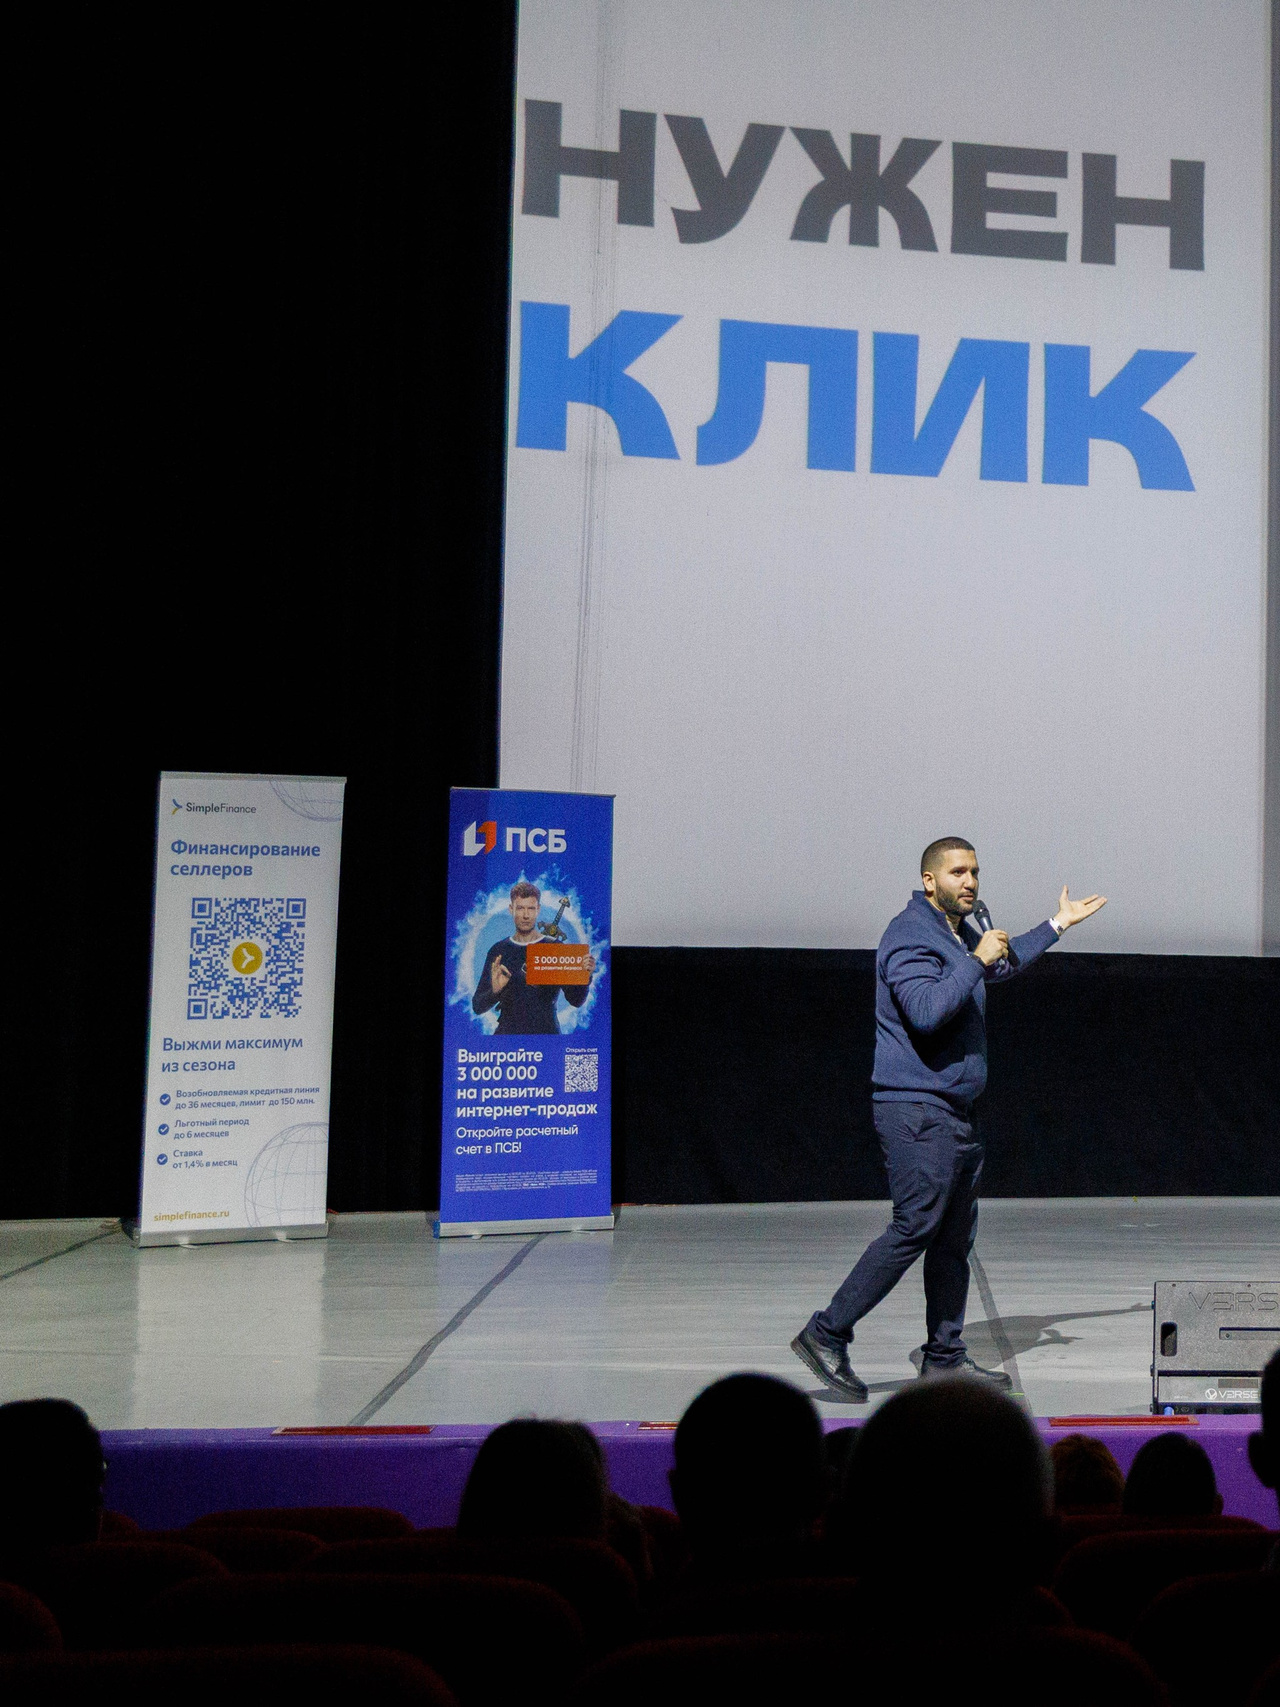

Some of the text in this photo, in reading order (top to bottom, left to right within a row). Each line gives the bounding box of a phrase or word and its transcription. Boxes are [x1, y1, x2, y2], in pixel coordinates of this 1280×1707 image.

[521, 99, 1205, 271] НУЖЕН
[515, 300, 1198, 492] КЛИК
[186, 802, 256, 815] SimpleFinance
[506, 827, 567, 853] ПСБ
[171, 839, 321, 859] Финансирование
[170, 864, 253, 879] селлеров
[534, 956, 539, 964] 3
[163, 1037, 303, 1051] Выжми максимум
[458, 1048, 543, 1065] Выиграйте
[162, 1060, 235, 1072] из сезона
[457, 1066, 537, 1081] 3 000 000
[177, 1086, 319, 1098] Возобновляемая кредитная линия
[457, 1087, 554, 1102] на развитие
[189, 1100, 199, 1109] 36
[201, 1100, 238, 1108] месяцев,
[240, 1099, 265, 1107] лимит
[269, 1098, 279, 1106] до
[281, 1097, 295, 1105] 150
[456, 1103, 598, 1120] интернет-продаж
[175, 1118, 249, 1128] Льготный период
[174, 1130, 229, 1140] до 6 месяцев
[456, 1125, 578, 1140] Откройте расчетный
[174, 1149, 203, 1157] Ставка
[456, 1142, 522, 1155] счет в ПСБ!
[173, 1161, 182, 1169] от
[184, 1160, 204, 1169] 1,4%
[213, 1159, 238, 1168] месяц
[154, 1210, 229, 1222] simplefinance.ru
[1218, 1390, 1259, 1399] VERSE
